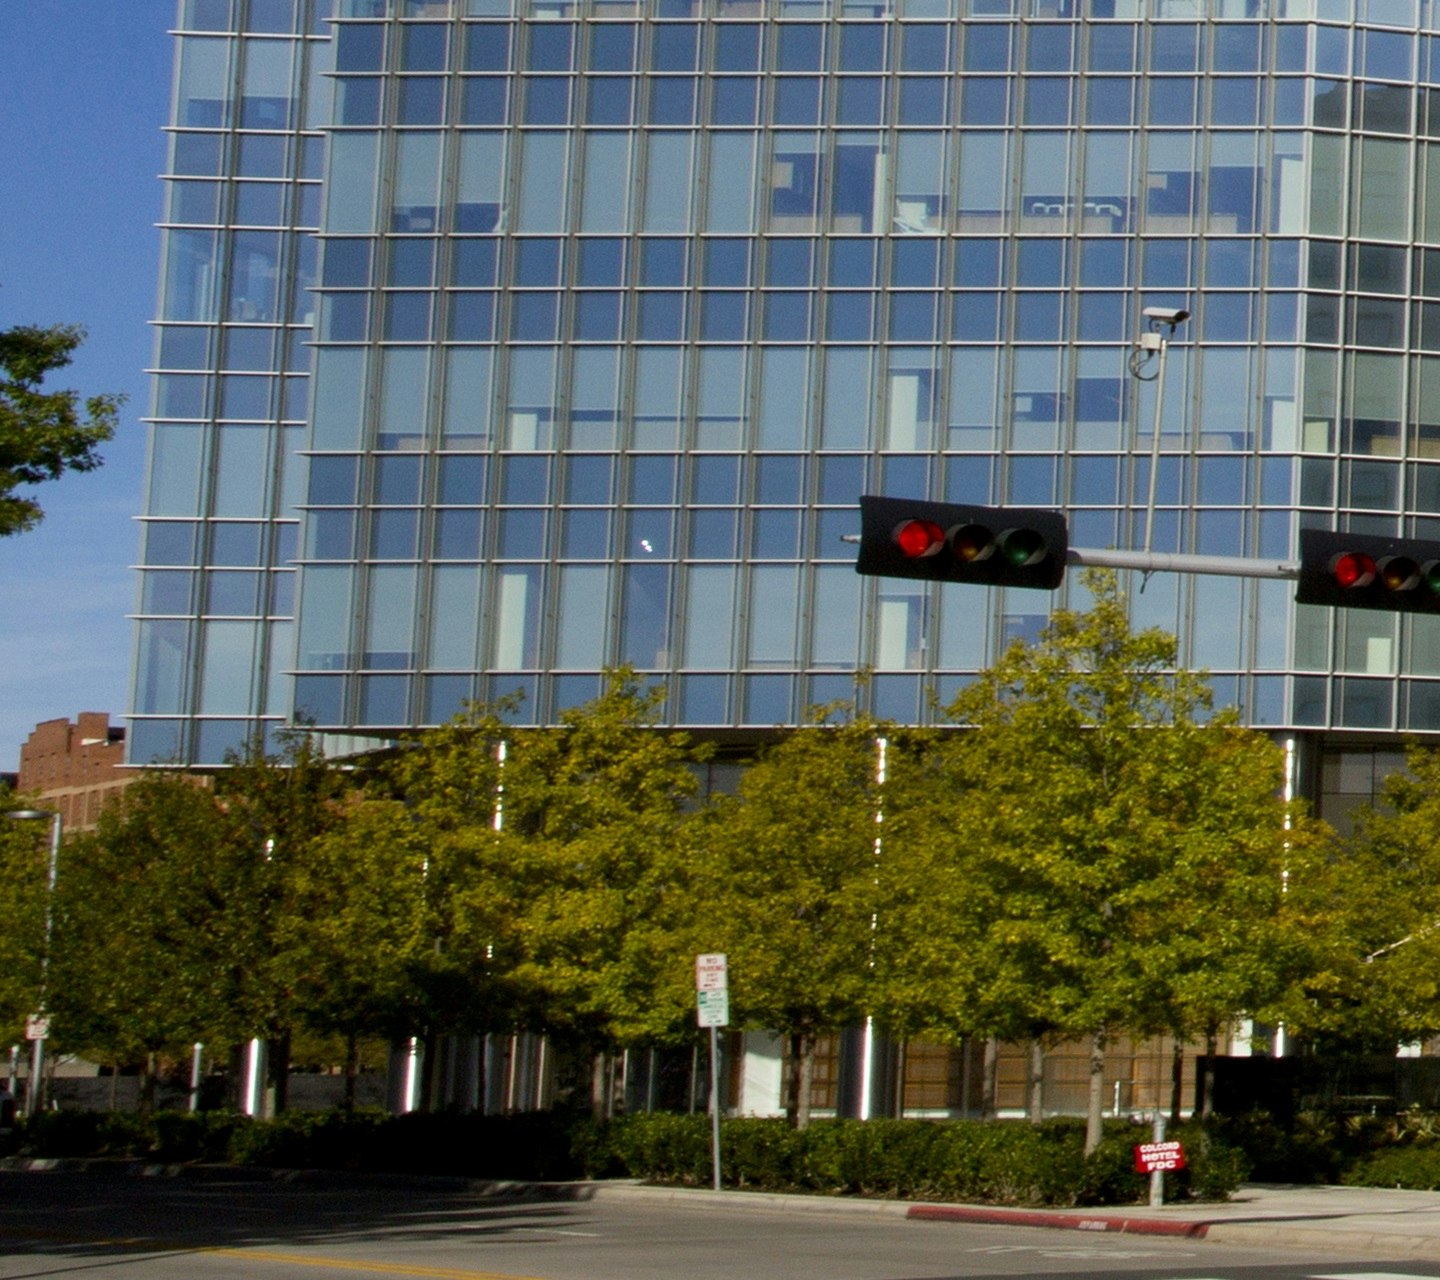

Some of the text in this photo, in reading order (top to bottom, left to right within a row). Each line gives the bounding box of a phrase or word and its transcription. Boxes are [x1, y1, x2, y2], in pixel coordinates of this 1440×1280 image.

[1140, 1141, 1180, 1153] COLCORD
[1141, 1150, 1180, 1162] HOTEL
[1147, 1160, 1176, 1171] FDC
